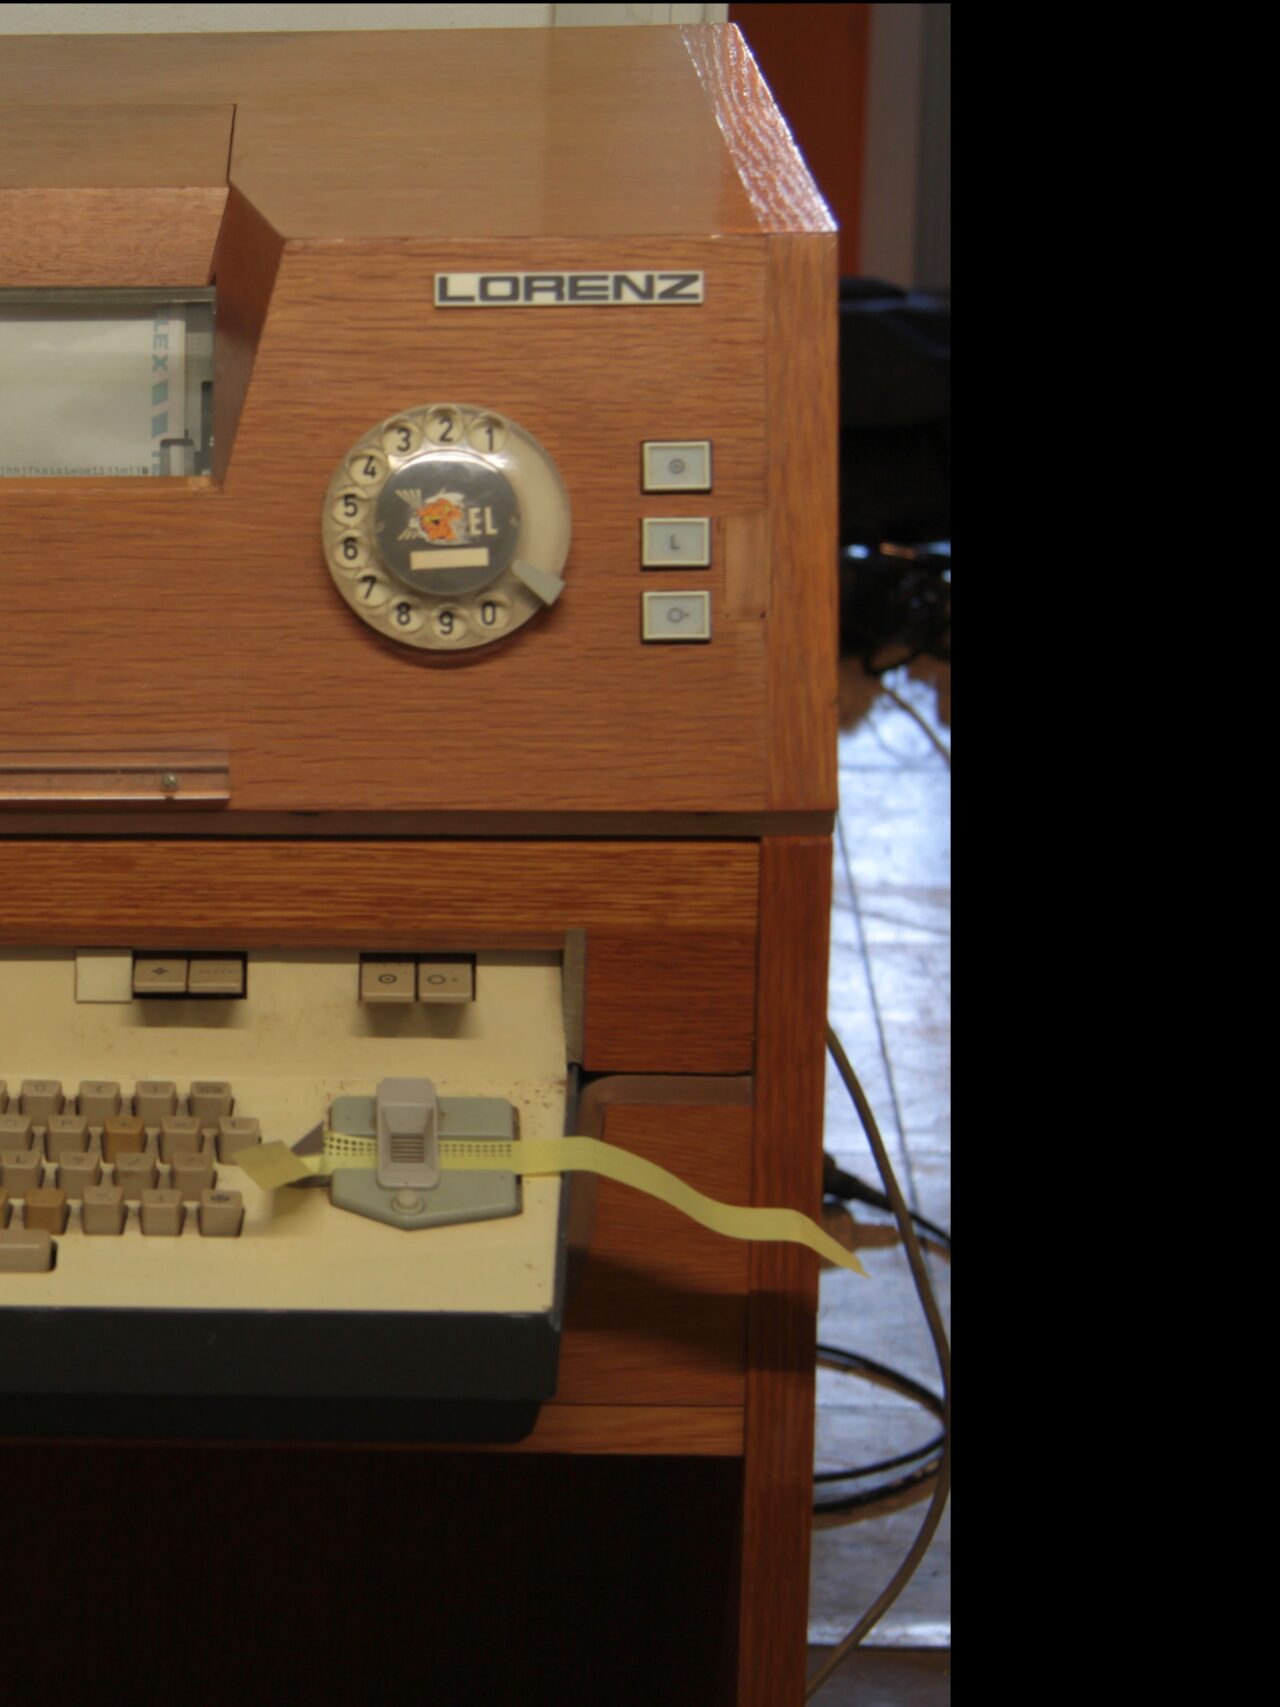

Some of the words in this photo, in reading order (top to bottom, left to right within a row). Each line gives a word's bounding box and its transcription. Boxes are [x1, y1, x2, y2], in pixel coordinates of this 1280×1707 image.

[437, 273, 700, 303] LORENZ
[396, 427, 412, 453] 3
[438, 417, 454, 443] 2
[485, 426, 494, 452] 1
[363, 455, 378, 479] 4
[343, 493, 359, 518] 5
[342, 536, 359, 561] 6
[669, 534, 681, 551] L
[362, 575, 378, 600] 7
[396, 601, 413, 626] 8
[438, 610, 455, 636] 9
[480, 601, 497, 626] 0
